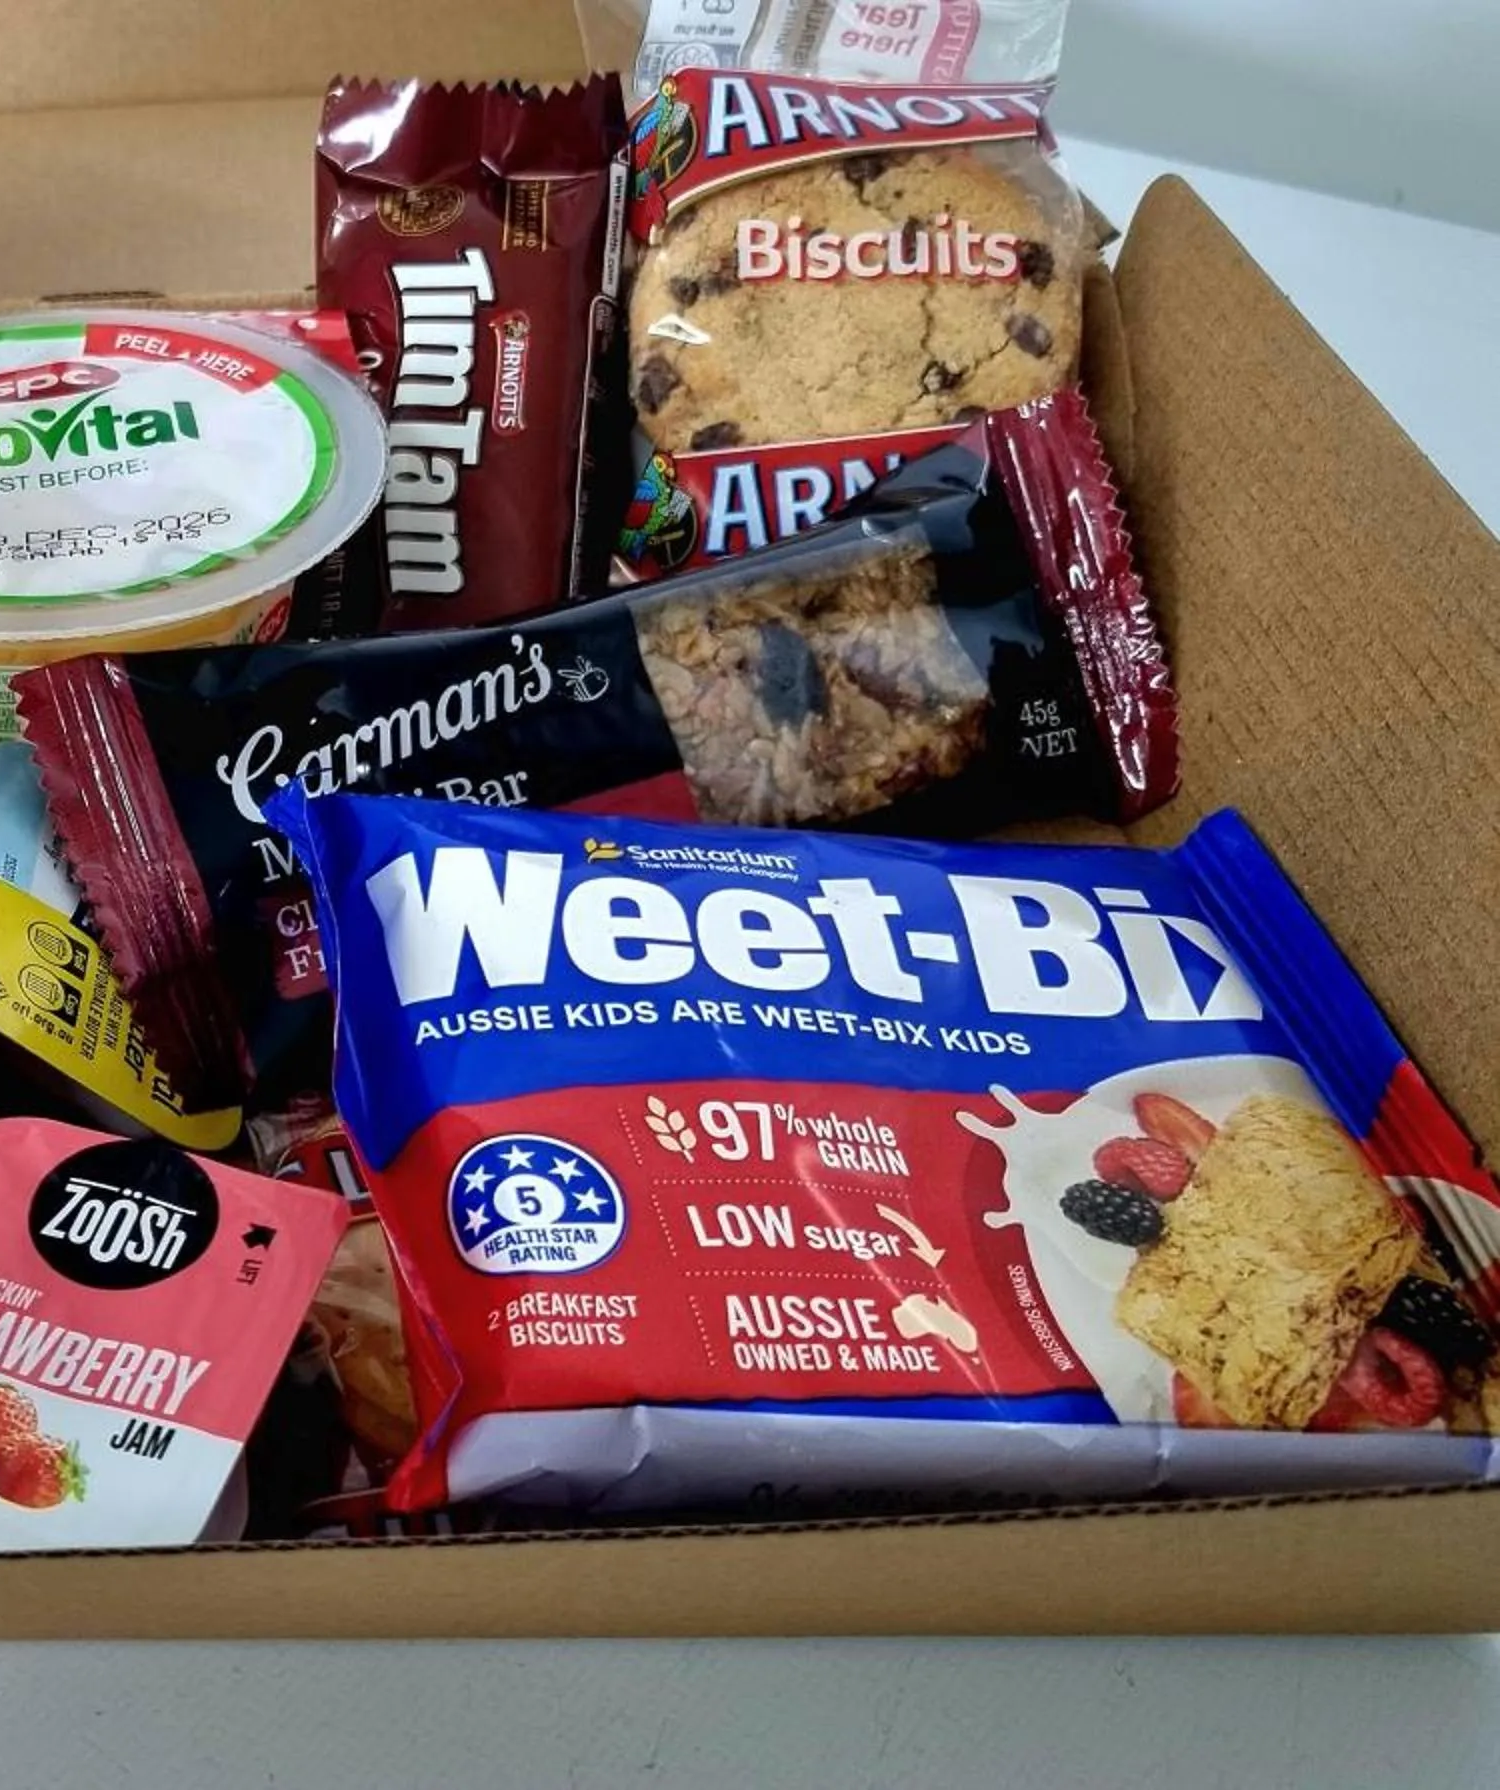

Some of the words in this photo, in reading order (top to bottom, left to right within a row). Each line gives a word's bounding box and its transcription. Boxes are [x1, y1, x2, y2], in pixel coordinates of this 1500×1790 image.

[736, 215, 1021, 281] Biscuits
[115, 333, 170, 357] PEEL
[195, 351, 255, 381] HERE
[39, 458, 148, 488] BEFORE:
[26, 524, 117, 547] DEC
[133, 507, 231, 535] 2026
[216, 634, 552, 823] Carman's
[1020, 700, 1061, 728] 45g
[1021, 728, 1079, 759] NET
[415, 1004, 553, 1046] AUSSIE
[564, 1001, 659, 1030] KIDS
[671, 1000, 744, 1026] ARE
[753, 1005, 932, 1048] WEET-BIX
[941, 1027, 1031, 1056] KIDS
[809, 1115, 898, 1149] whole
[821, 1145, 910, 1177] GRAIN
[519, 1186, 542, 1217] 5
[483, 1224, 551, 1259] HEALTH
[553, 1226, 598, 1246] STAR
[688, 1204, 795, 1249] LOW
[803, 1223, 901, 1261] sugar
[508, 1244, 577, 1265] RATING
[237, 1259, 262, 1287] LIFT
[488, 1310, 502, 1331] 2
[506, 1293, 638, 1321] BREAKFAST
[727, 1295, 887, 1341] AUSSIE
[1008, 1263, 1032, 1312] SERVING
[1027, 1311, 1074, 1373] SUGGESTION
[510, 1321, 626, 1348] BISCUITS
[733, 1343, 831, 1373] OWNED
[836, 1346, 859, 1372] &
[864, 1346, 940, 1373] MADE
[109, 1417, 177, 1461] JAM
